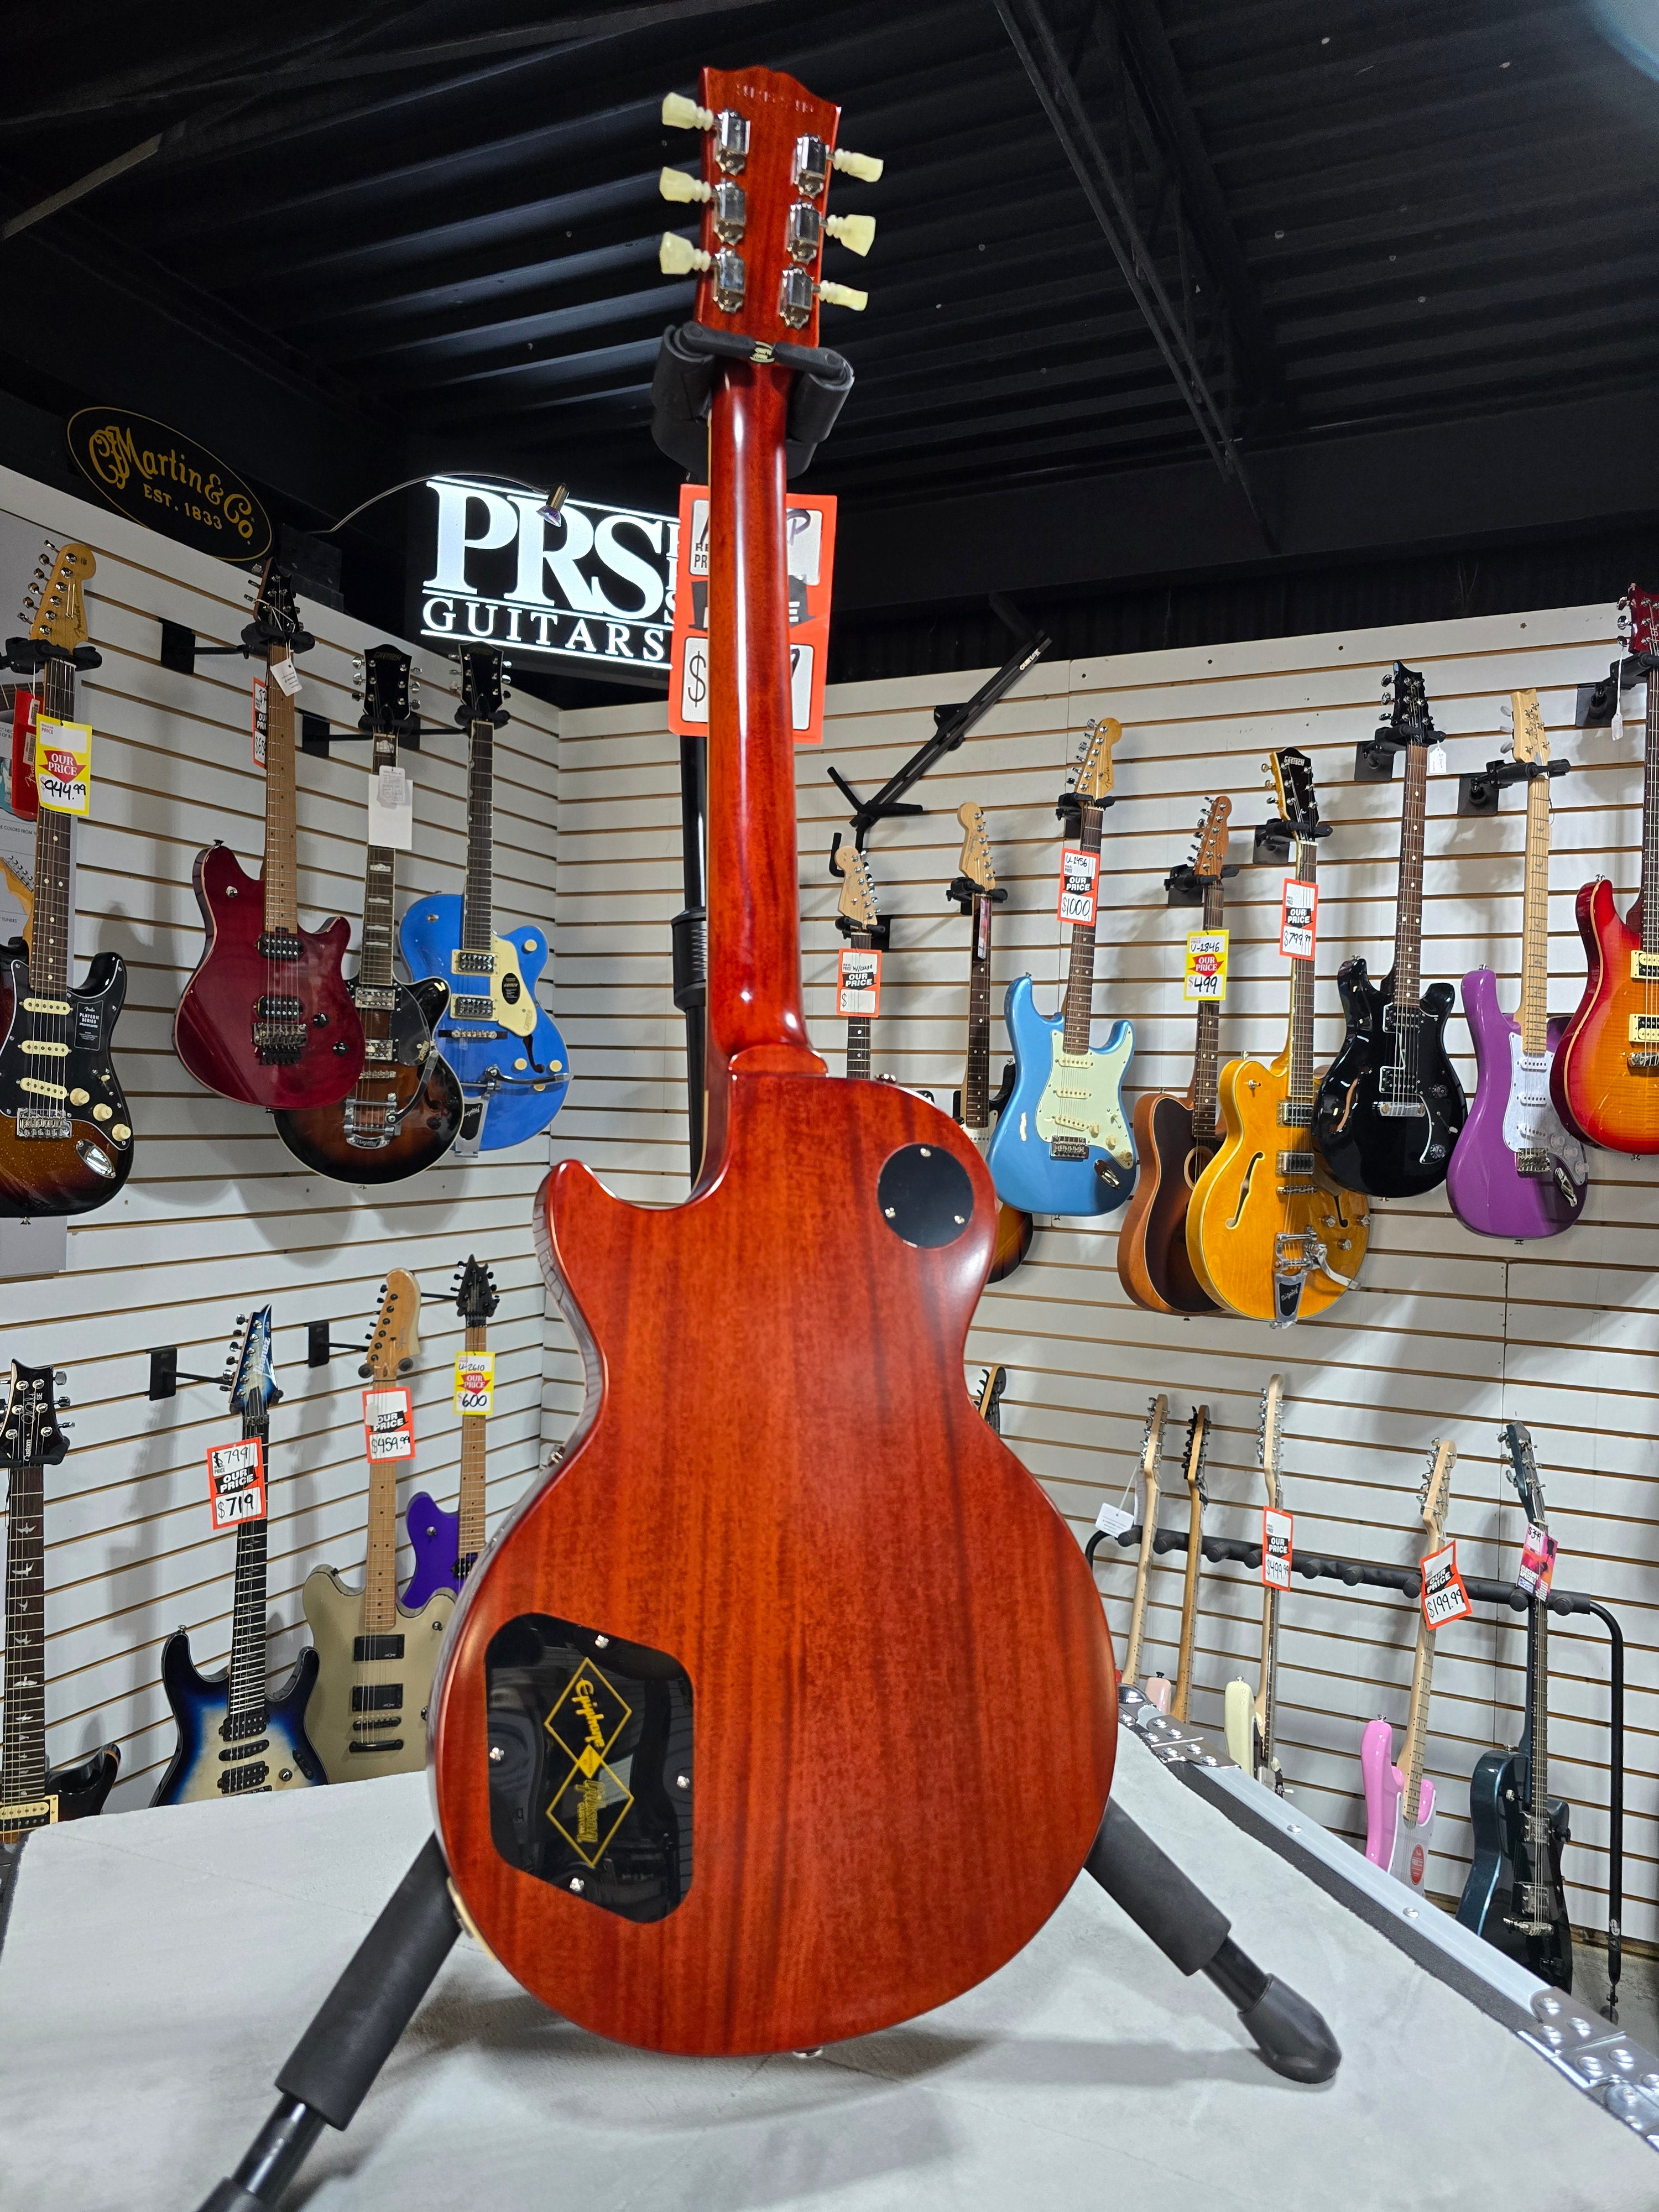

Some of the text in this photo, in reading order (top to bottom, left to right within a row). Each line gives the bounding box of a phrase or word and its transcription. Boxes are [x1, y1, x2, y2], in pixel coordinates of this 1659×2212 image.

[185, 502, 222, 530] 1833
[423, 481, 665, 619] PRS
[422, 597, 665, 662] GUITARS
[258, 712, 267, 721] OU
[51, 753, 74, 766] OUR
[1284, 755, 1305, 766] GRETSCH
[48, 762, 77, 776] PRICE
[1062, 896, 1091, 916] $1000
[1287, 916, 1311, 924] PRICE
[845, 978, 873, 987] PRICE
[1188, 976, 1218, 994] $499
[253, 1337, 271, 1373] Ibanez
[36, 1392, 43, 1401] SE
[458, 1392, 488, 1408] $600
[373, 1417, 404, 1432] PRICE
[377, 1412, 398, 1424] OUR
[220, 1473, 254, 1494] PRICE
[223, 1468, 248, 1484] OUR
[218, 1493, 254, 1520] $719
[1269, 1544, 1288, 1554] PRICE
[1271, 1537, 1285, 1546] OUR
[1427, 1571, 1452, 1594] PRICE
[1429, 1569, 1446, 1585] OUR
[1427, 1588, 1465, 1619] $199.99
[571, 1678, 605, 1747] Epiphone
